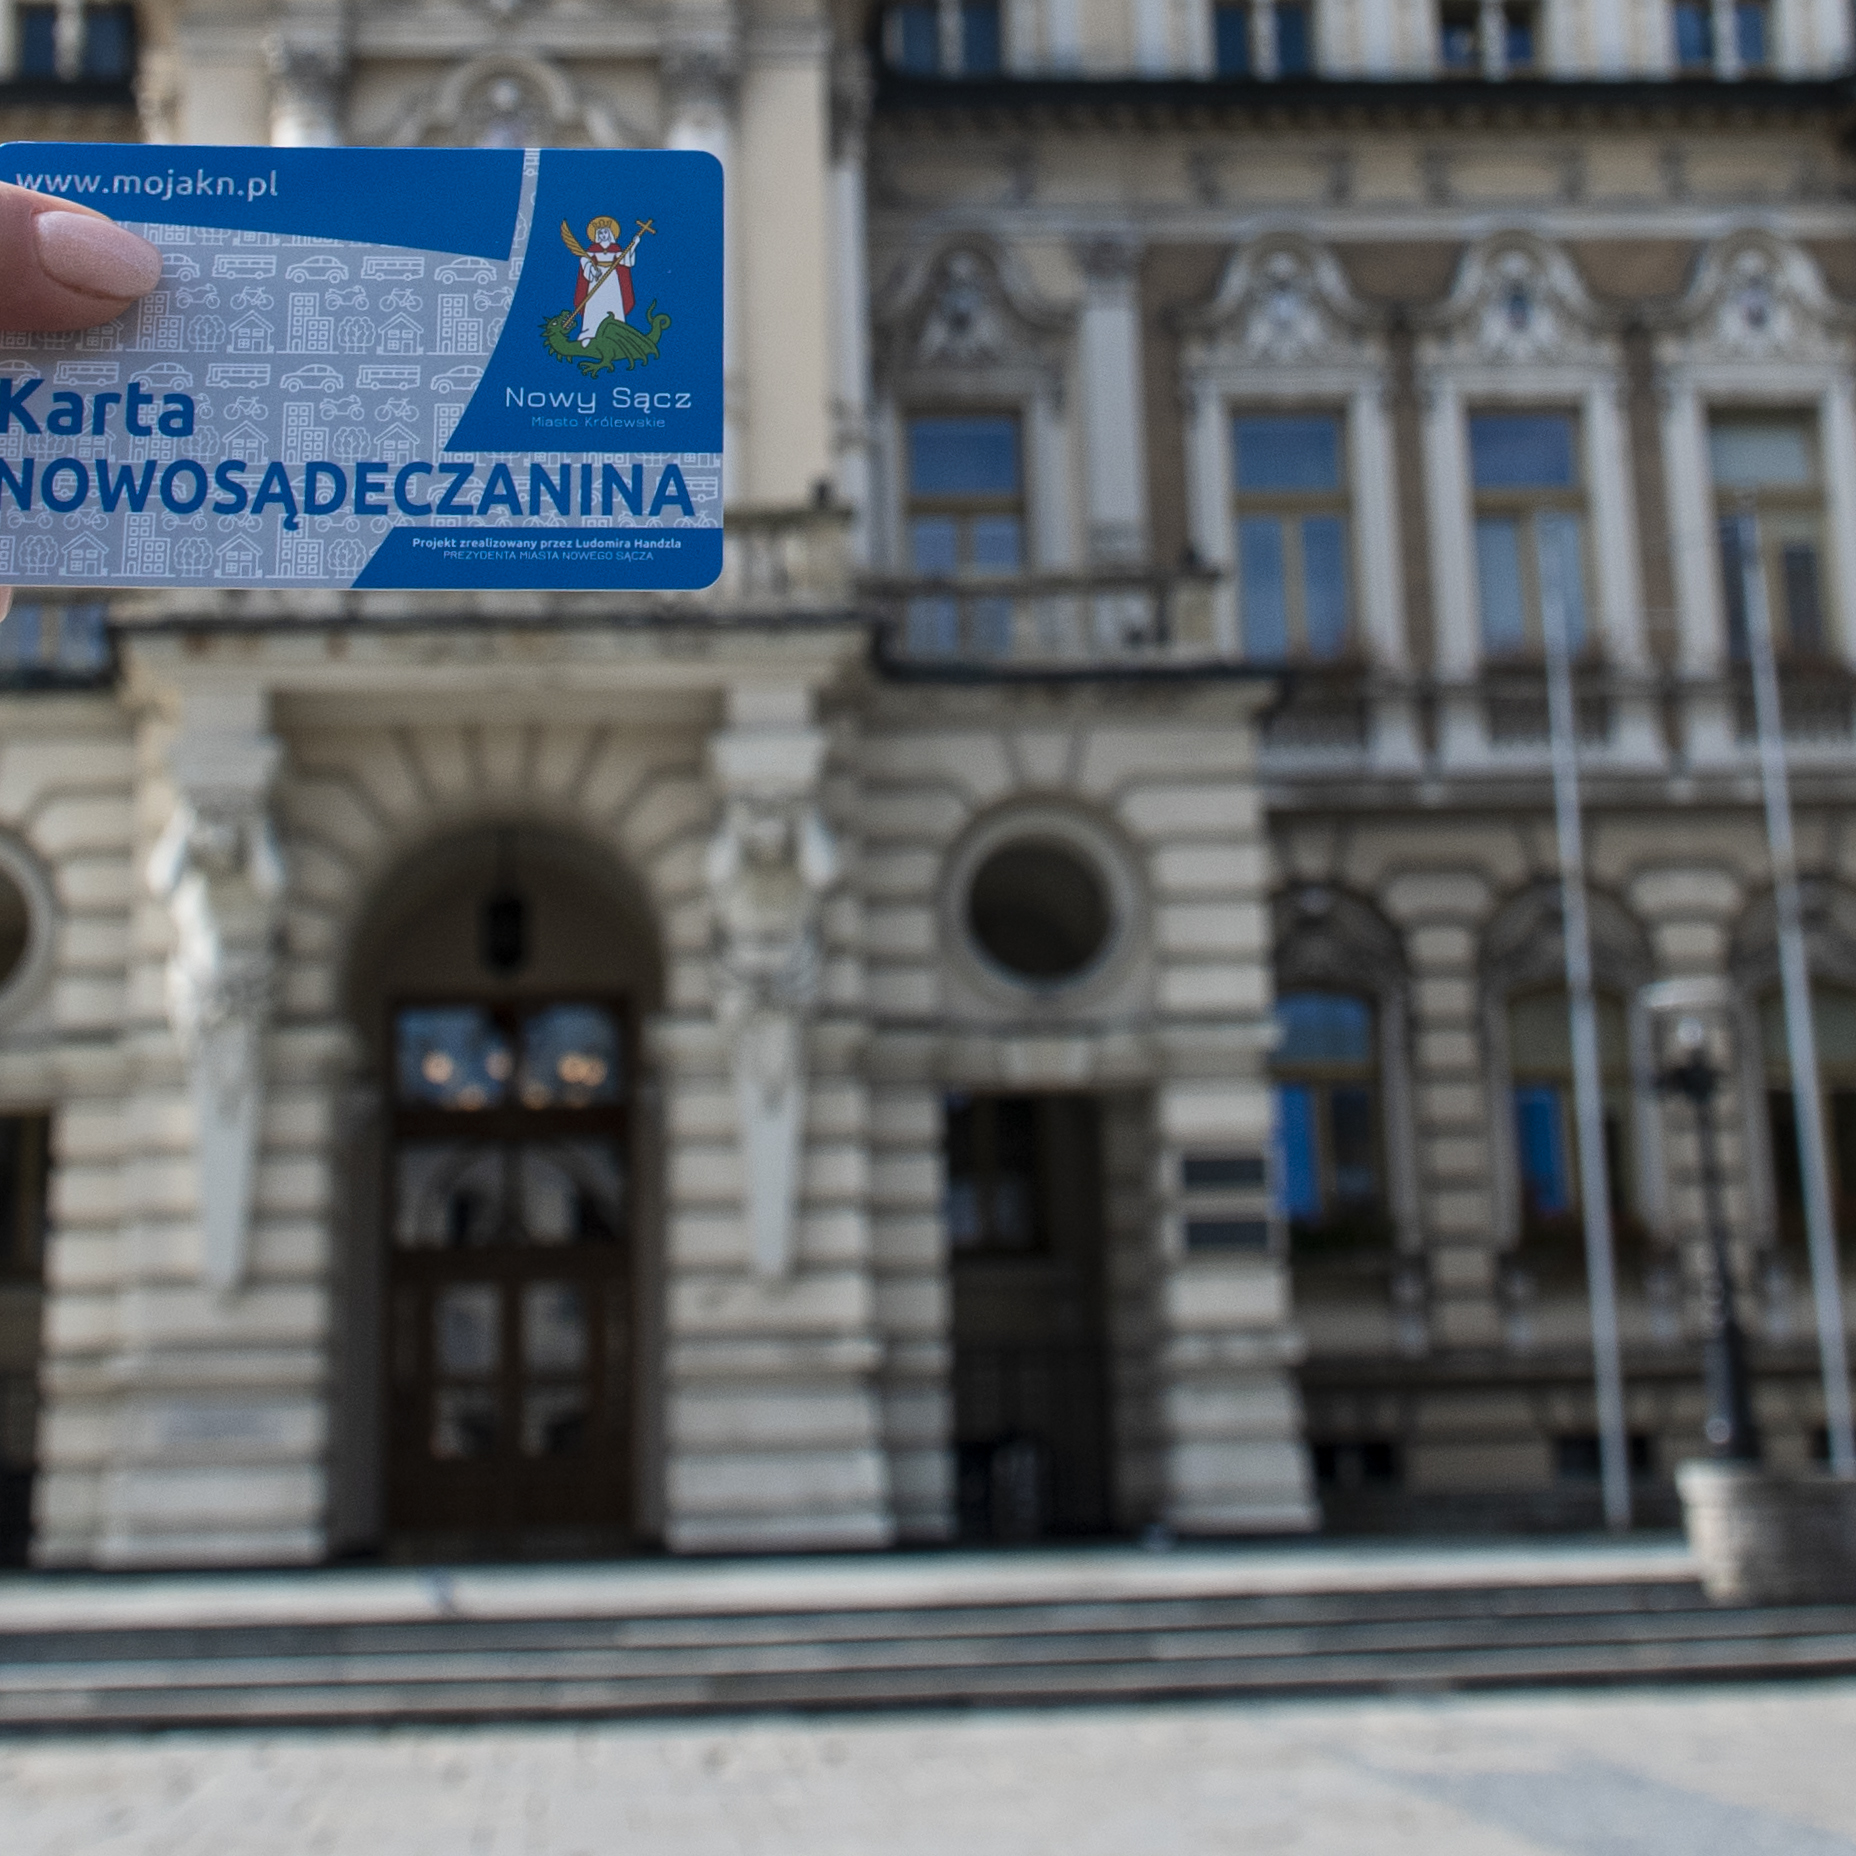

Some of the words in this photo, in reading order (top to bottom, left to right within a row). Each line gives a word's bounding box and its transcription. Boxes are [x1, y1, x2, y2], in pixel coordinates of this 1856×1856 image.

[16, 168, 278, 202] www.mojakn.pl
[505, 386, 596, 414] Nowy
[612, 386, 692, 414] Sącz
[531, 416, 578, 428] Miasto
[584, 416, 666, 428] Królewskie
[412, 537, 457, 550] Projekt
[459, 537, 537, 550] zrealizowany
[540, 539, 573, 550] przez
[575, 537, 631, 549] Ludomira
[634, 537, 682, 549] Handzla
[443, 550, 517, 561] PREZYDENTA
[519, 550, 560, 561] MIASTA
[562, 551, 613, 561] NOWEGO
[615, 551, 654, 562] SĄCZA
